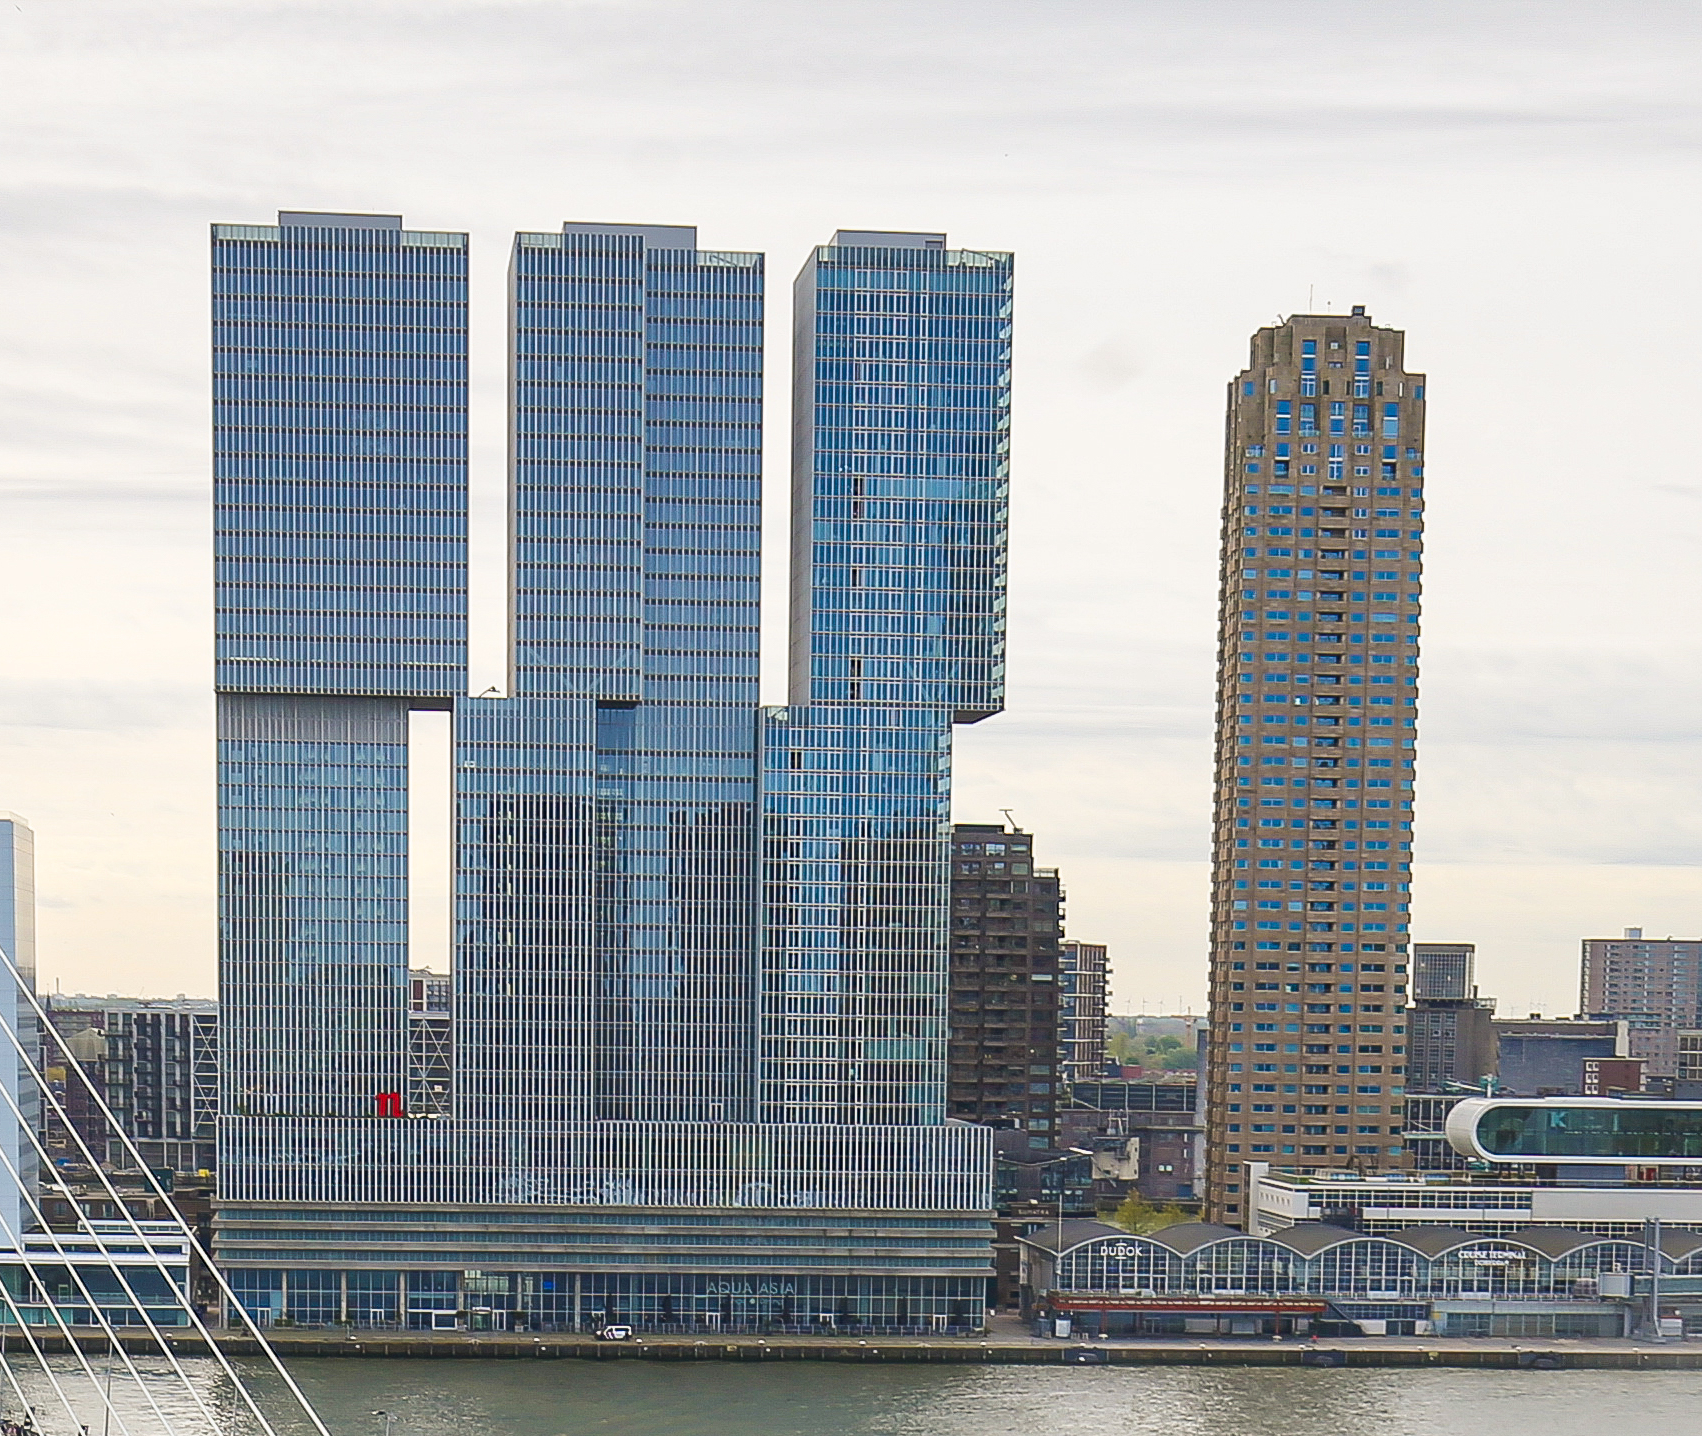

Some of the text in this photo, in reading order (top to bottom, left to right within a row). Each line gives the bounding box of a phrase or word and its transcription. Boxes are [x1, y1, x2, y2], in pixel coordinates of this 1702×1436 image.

[1100, 1246, 1143, 1257] DUDOK
[707, 1281, 795, 1295] AQUA ASIA
